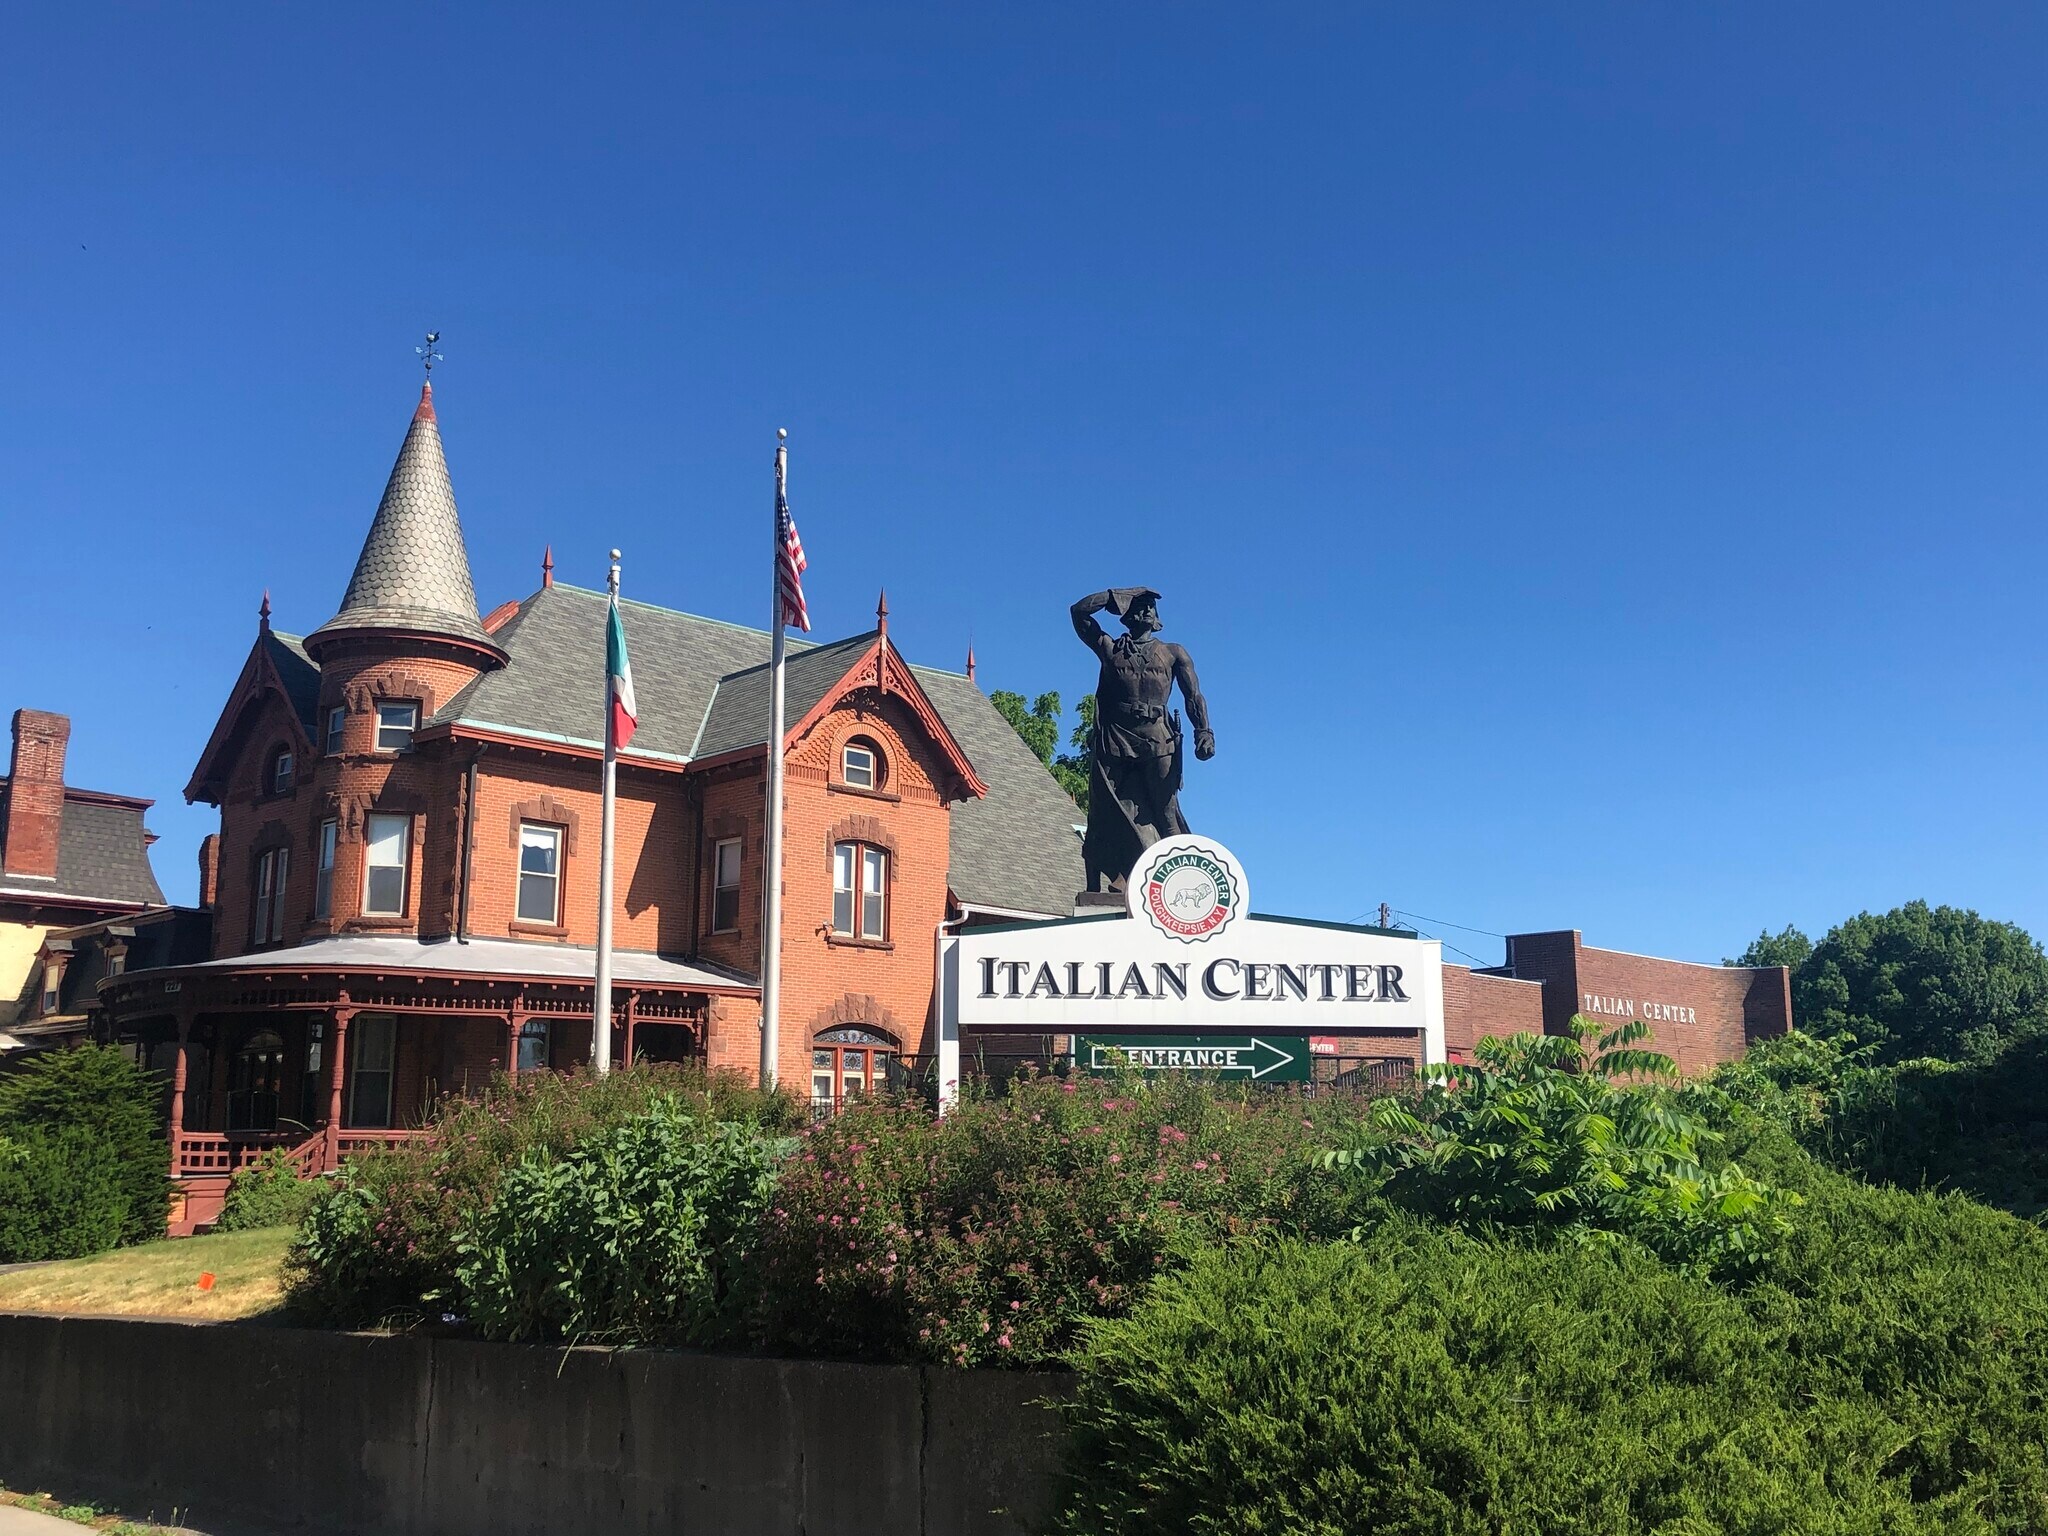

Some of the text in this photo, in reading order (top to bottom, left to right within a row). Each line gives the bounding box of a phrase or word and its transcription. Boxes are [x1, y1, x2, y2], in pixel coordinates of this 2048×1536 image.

[1156, 856, 1229, 900] ITALIAN CENTER
[1150, 886, 1226, 934] POUGHKEEPSIE, N.Y.
[976, 957, 1412, 1003] ITALIAN CENTER
[1584, 994, 1697, 1024] TALIAN CENTER
[1127, 1050, 1238, 1066] ENTRANCE
